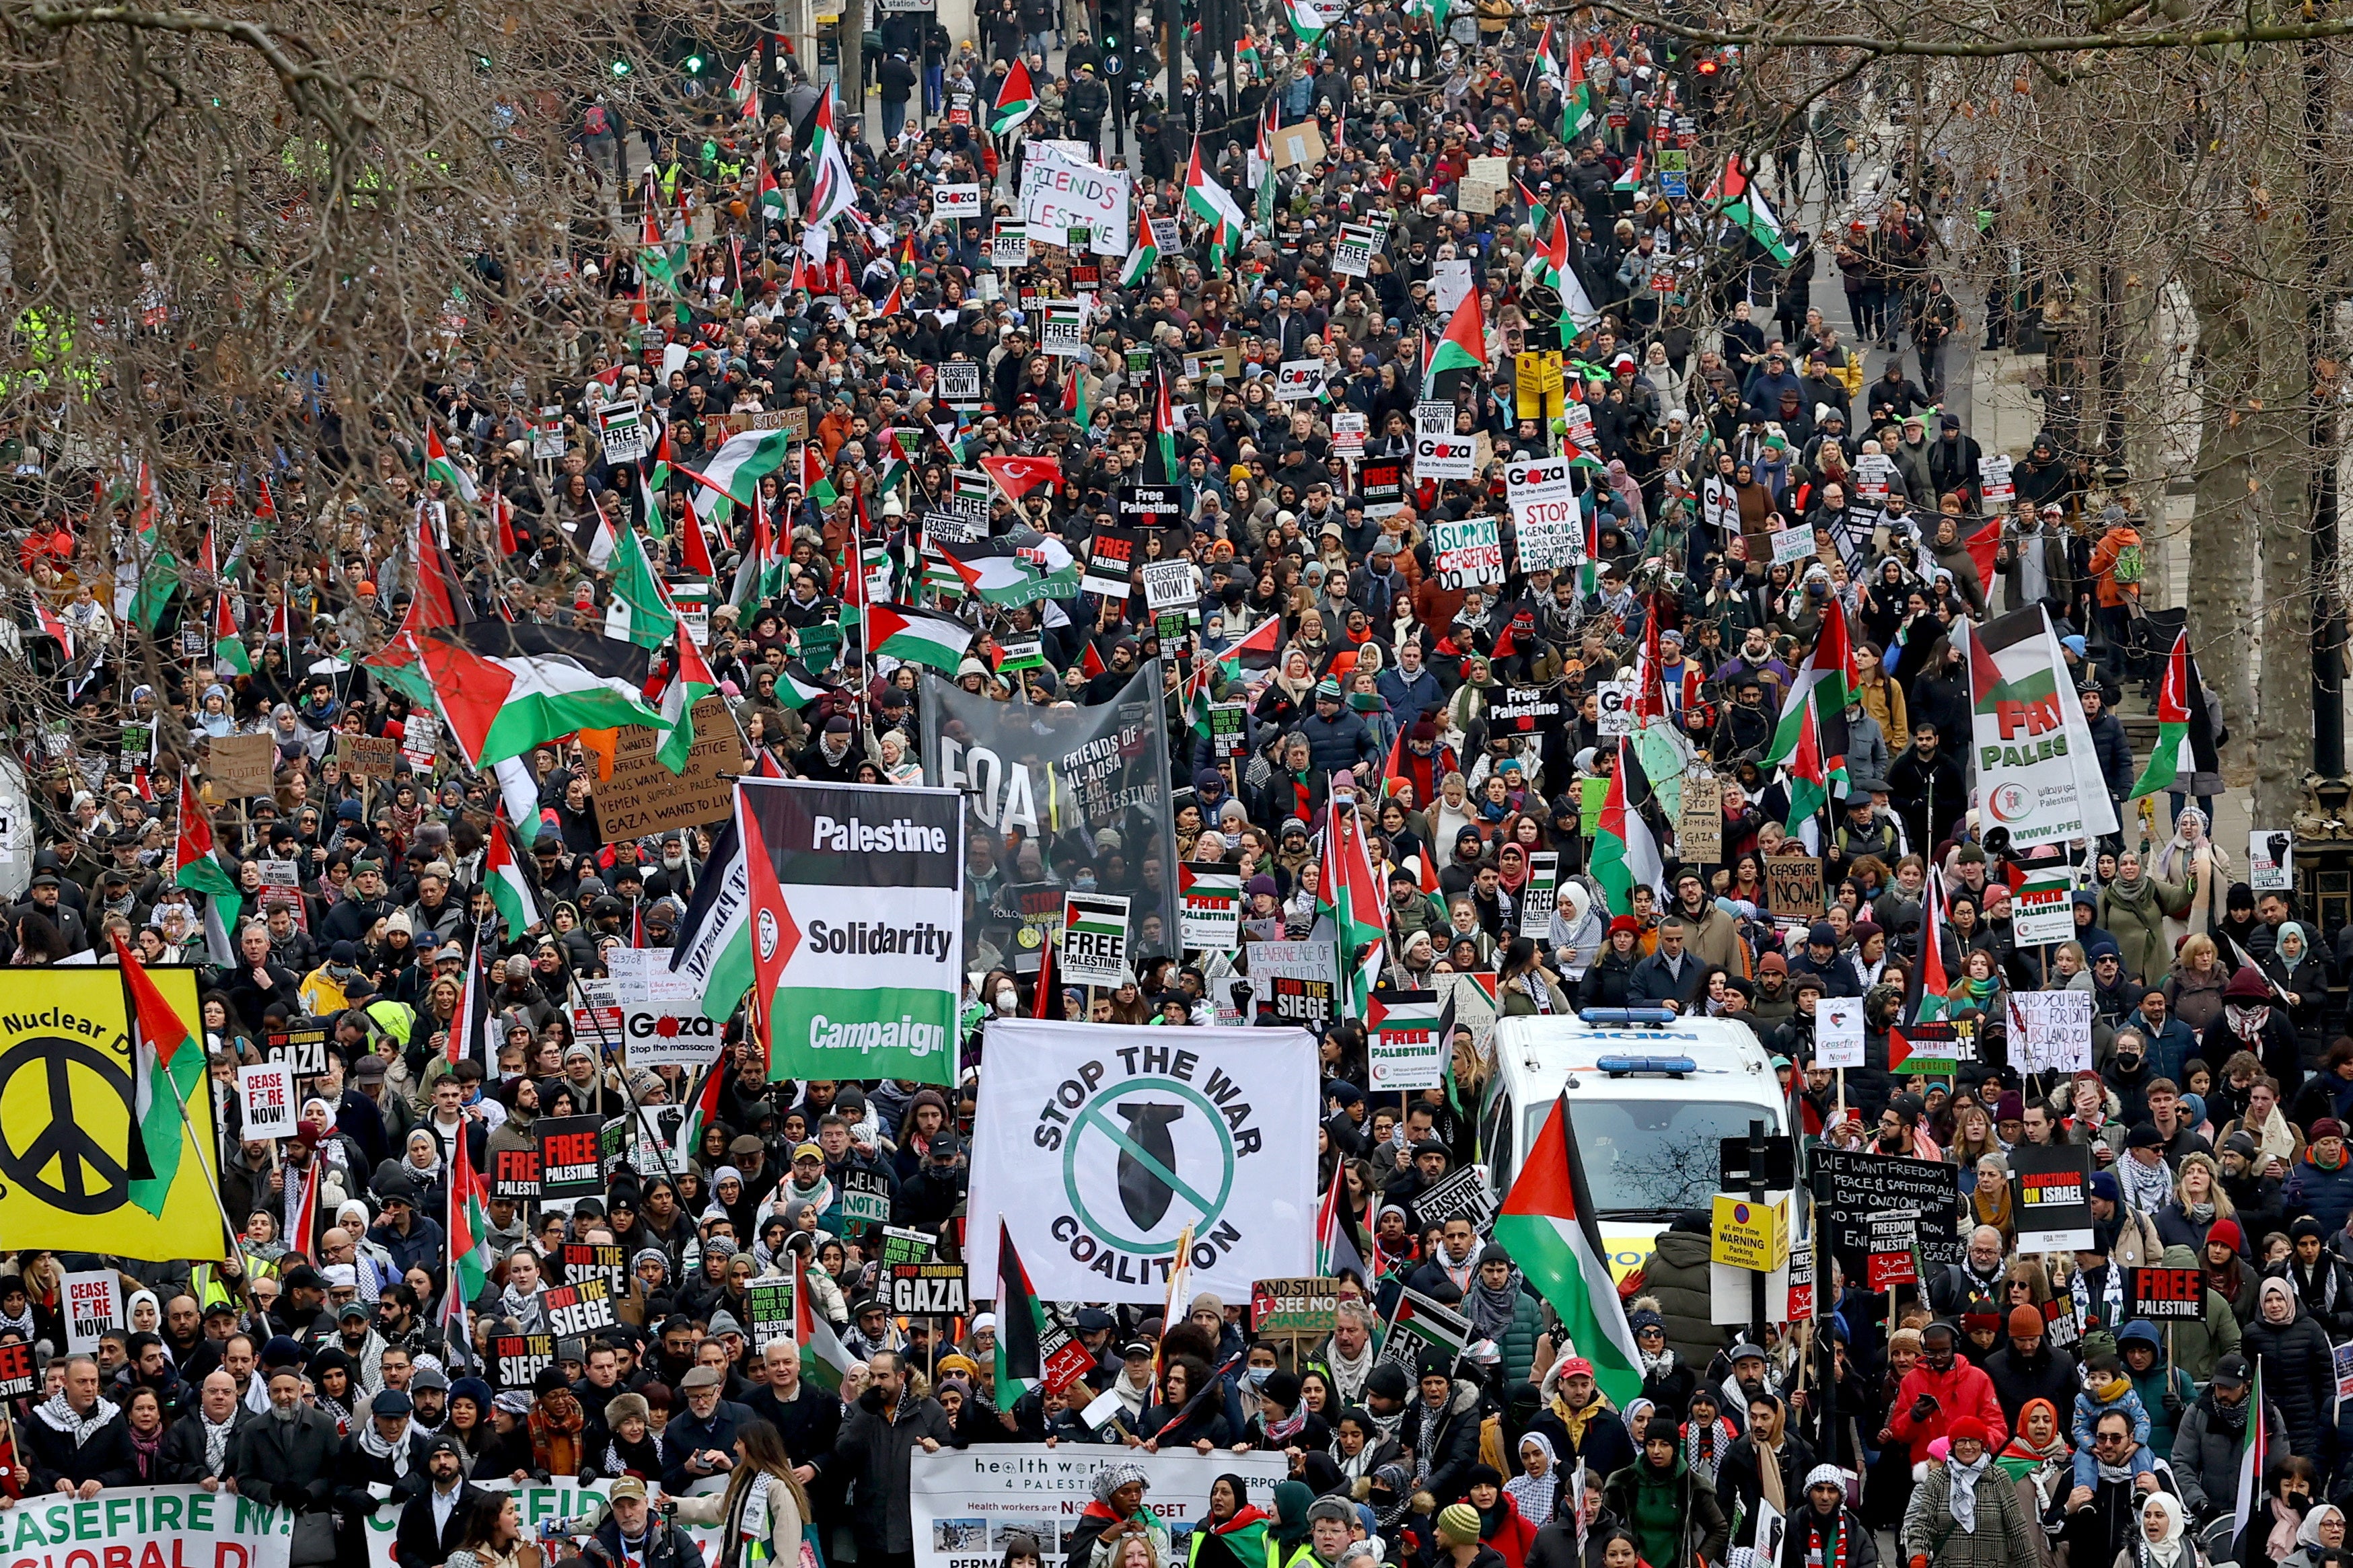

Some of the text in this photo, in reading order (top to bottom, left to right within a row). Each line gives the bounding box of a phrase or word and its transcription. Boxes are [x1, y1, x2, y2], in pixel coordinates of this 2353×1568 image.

[994, 239, 1025, 250] FREE
[1337, 245, 1369, 260] FREE
[1071, 266, 1098, 281] FREE
[1044, 324, 1079, 337] FREE
[940, 367, 976, 379] CEASEFIRE
[945, 379, 974, 392] NOW!
[1418, 407, 1453, 418] CEASEFIRE
[1422, 418, 1450, 434] NOW!
[606, 427, 639, 446] FREE
[607, 439, 643, 453] PALESTINE
[1419, 440, 1470, 458] Gza
[1363, 465, 1400, 486] FREE
[1509, 466, 1564, 486] Gza
[1136, 489, 1163, 501] Free
[1365, 485, 1399, 495] PALESTINE
[954, 498, 987, 515] FREE
[1120, 501, 1178, 514] Palestine
[1527, 502, 1568, 524] STOP
[925, 520, 965, 536] CEASEFIRE
[1525, 521, 1577, 537] GENOCIDE
[1528, 533, 1581, 548] WAR CRIMES
[1774, 528, 1812, 547] PALESTINE
[1094, 536, 1132, 560] FREE
[1531, 544, 1586, 558] OCCUPATION
[1778, 544, 1811, 562] HUMANITY
[1091, 556, 1129, 571] PALESTINE
[1437, 545, 1501, 571] CEASEFIRE
[1531, 555, 1579, 570] HYPOCRISY
[1145, 567, 1190, 585] CEASEFIRE
[1153, 579, 1190, 601] NOW!
[1160, 636, 1187, 646] PALESTINE
[1507, 688, 1540, 702] Free
[1491, 701, 1559, 718] Palestine
[1214, 734, 1245, 743] PALESTINE
[1063, 726, 1137, 771] FRIENDS OF
[1216, 749, 1230, 757] FREE
[227, 768, 266, 778] JUSTICE
[1067, 753, 1122, 790] AL-AQSA
[813, 816, 947, 854] Palestine
[1685, 832, 1714, 844] GAZA
[1525, 890, 1551, 910] FREE
[1775, 881, 1819, 905] NOW!
[2021, 889, 2063, 907] FREE
[1187, 895, 1231, 909] FREE
[1181, 911, 1235, 921] PALESTINE
[1524, 909, 1550, 922] PALESTINE
[2015, 903, 2070, 918] PALESTINE
[809, 920, 952, 962] Solidarity
[1065, 932, 1122, 957] FREE
[614, 956, 641, 964] 23708
[1064, 954, 1121, 969] PALESTINE
[1249, 945, 1329, 962] THE AVERAGE AGE OF
[1278, 981, 1302, 994] END
[1305, 981, 1328, 998] THE
[1278, 994, 1329, 1020] SIEGE
[2, 1007, 106, 1039] Nuclear
[629, 1012, 713, 1037] Gza
[268, 1031, 324, 1045] STOP BOMBING
[810, 1014, 944, 1056] Campaign
[1380, 1029, 1428, 1045] FREE
[630, 1045, 650, 1053] Stop
[1821, 1039, 1858, 1048] Ceasefire
[1916, 1042, 1947, 1050] STARMER
[1371, 1047, 1437, 1058] PALESTINE
[1830, 1053, 1850, 1061] Now!
[1911, 1061, 1951, 1070] GENOCIDE
[248, 1073, 282, 1090] CEASE
[249, 1090, 285, 1107] FRE
[1034, 1046, 1262, 1158] STOP THE WAR
[251, 1107, 285, 1125] NOW!
[544, 1132, 596, 1165] FREE
[546, 1162, 598, 1182] PALESTINE
[1818, 1153, 1949, 1182] WE WANT FREEDOM,
[2022, 1171, 2080, 1187] SANCTIONS
[1838, 1191, 1943, 1211] BUT ONLY ONE WAY:
[2023, 1186, 2083, 1203] ON ISRAEL
[845, 1195, 888, 1217] NOT BE
[892, 1229, 912, 1238] Socialist
[1732, 1226, 1743, 1234] any
[1745, 1228, 1760, 1236] time
[1873, 1221, 1915, 1234] FREEDOM
[887, 1237, 927, 1255] FROM THE
[1719, 1232, 1764, 1249] WARNING
[565, 1246, 622, 1265] END THE
[1052, 1216, 1241, 1285] COALITON
[1729, 1245, 1753, 1257] Parking
[1924, 1252, 1951, 1261] GAZA
[1723, 1254, 1759, 1267] suspension
[1878, 1256, 1910, 1268] الحرية
[895, 1265, 963, 1277] STOP BOMBING
[1875, 1267, 1914, 1280] لفلسطين
[70, 1281, 108, 1300] CEASE
[752, 1286, 792, 1300] FROM THE
[1254, 1280, 1337, 1296] AND STILL
[2137, 1269, 2200, 1301] FREE
[545, 1279, 608, 1309] END THE
[895, 1279, 965, 1312] GAZA
[72, 1300, 112, 1318] FRE
[752, 1298, 789, 1310] RIVER TO
[1258, 1298, 1336, 1313] I SEE NO
[2137, 1300, 2198, 1315] PALESTINE
[548, 1298, 615, 1338] SIEGE
[753, 1309, 787, 1321] THE SEA
[1256, 1314, 1335, 1330] CHANGES
[75, 1317, 112, 1337] NOW!
[2048, 1314, 2078, 1342] SIEGE
[497, 1335, 552, 1356] END THE
[968, 1502, 999, 1511] Health
[1001, 1503, 1040, 1511] workers
